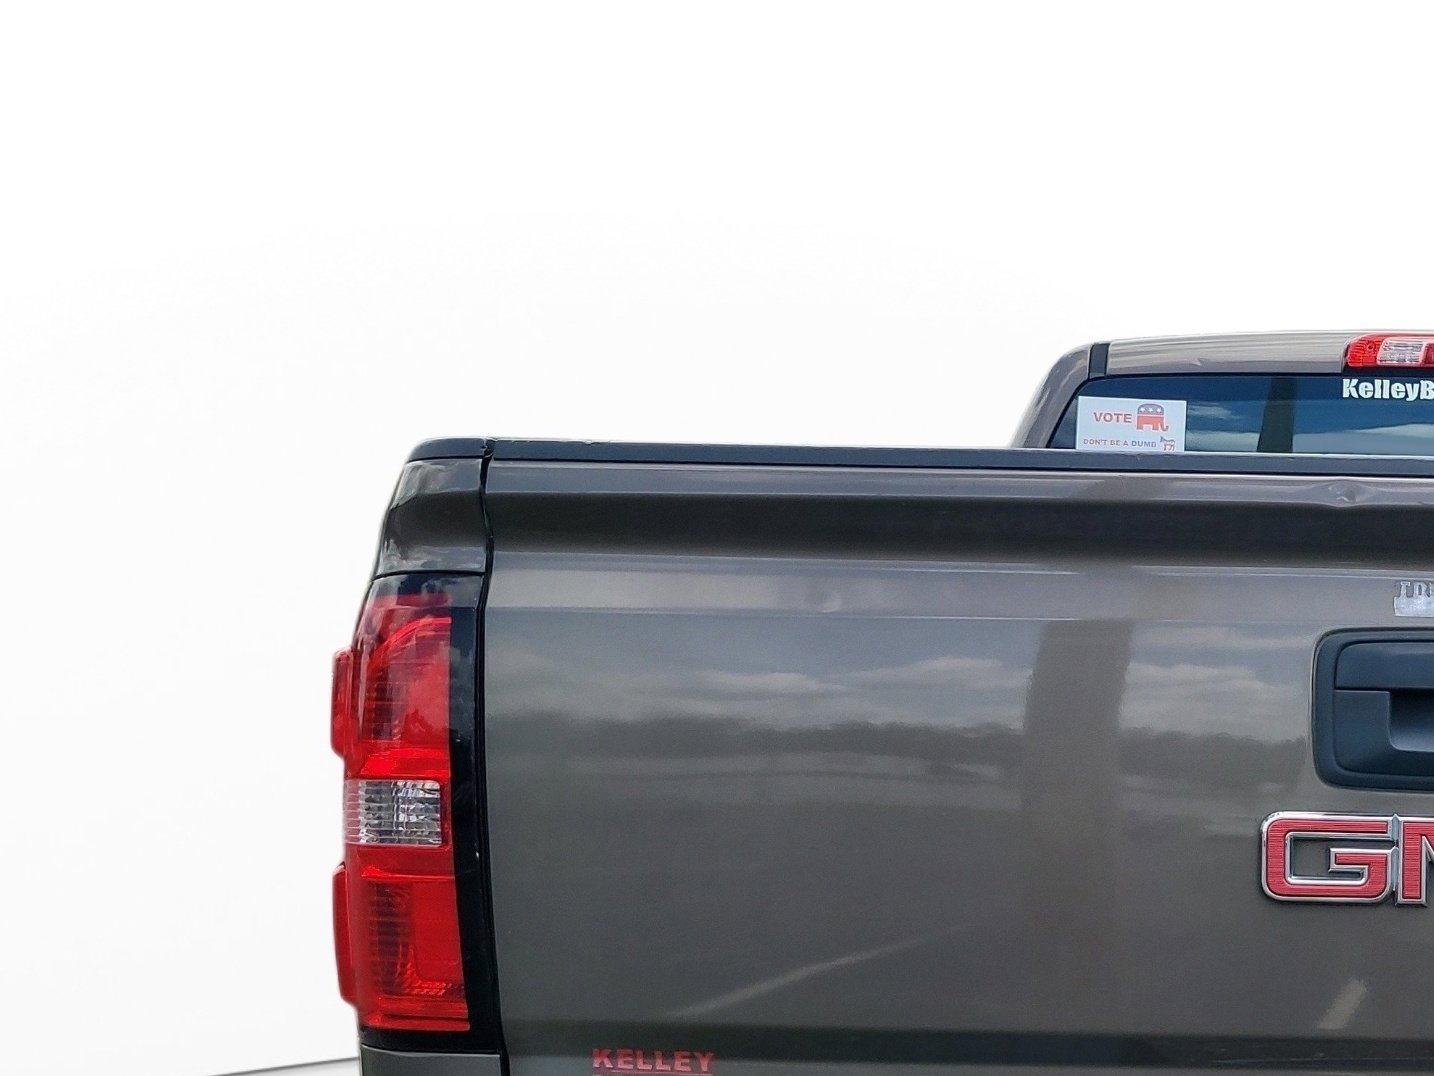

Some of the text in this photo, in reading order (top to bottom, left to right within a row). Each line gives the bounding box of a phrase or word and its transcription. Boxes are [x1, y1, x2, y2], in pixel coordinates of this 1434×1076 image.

[1093, 411, 1132, 424] VOTE
[1083, 438, 1107, 446] DON'T
[1110, 439, 1120, 447] BE
[1131, 440, 1157, 448] DUMB
[592, 1048, 715, 1072] KELLEY
